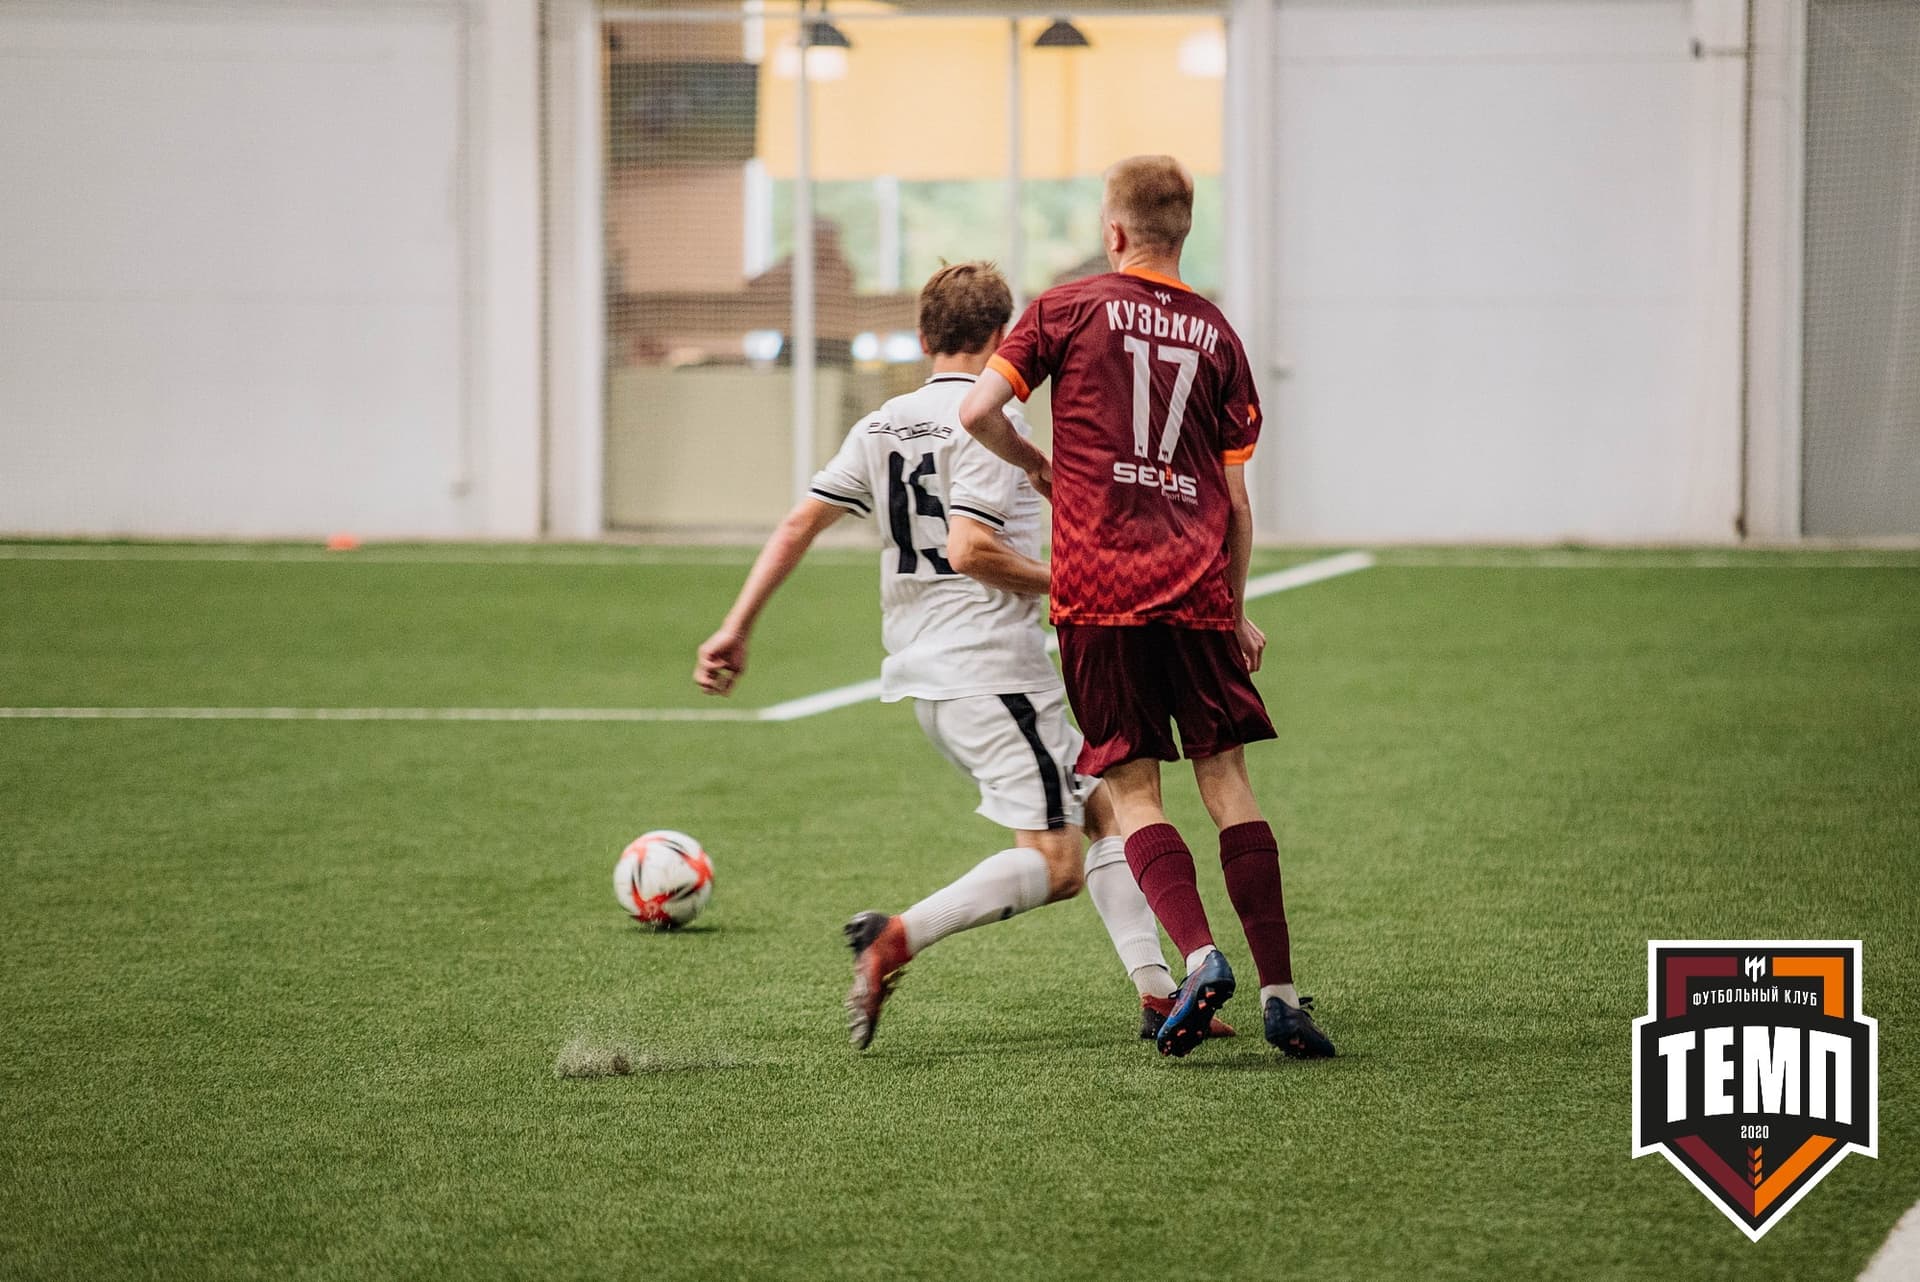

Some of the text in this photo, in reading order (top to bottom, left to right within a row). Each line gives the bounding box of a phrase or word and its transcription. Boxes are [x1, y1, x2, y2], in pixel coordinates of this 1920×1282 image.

[1106, 300, 1219, 354] КУЗЬКИН
[1124, 335, 1199, 464] 17
[888, 451, 960, 574] 15
